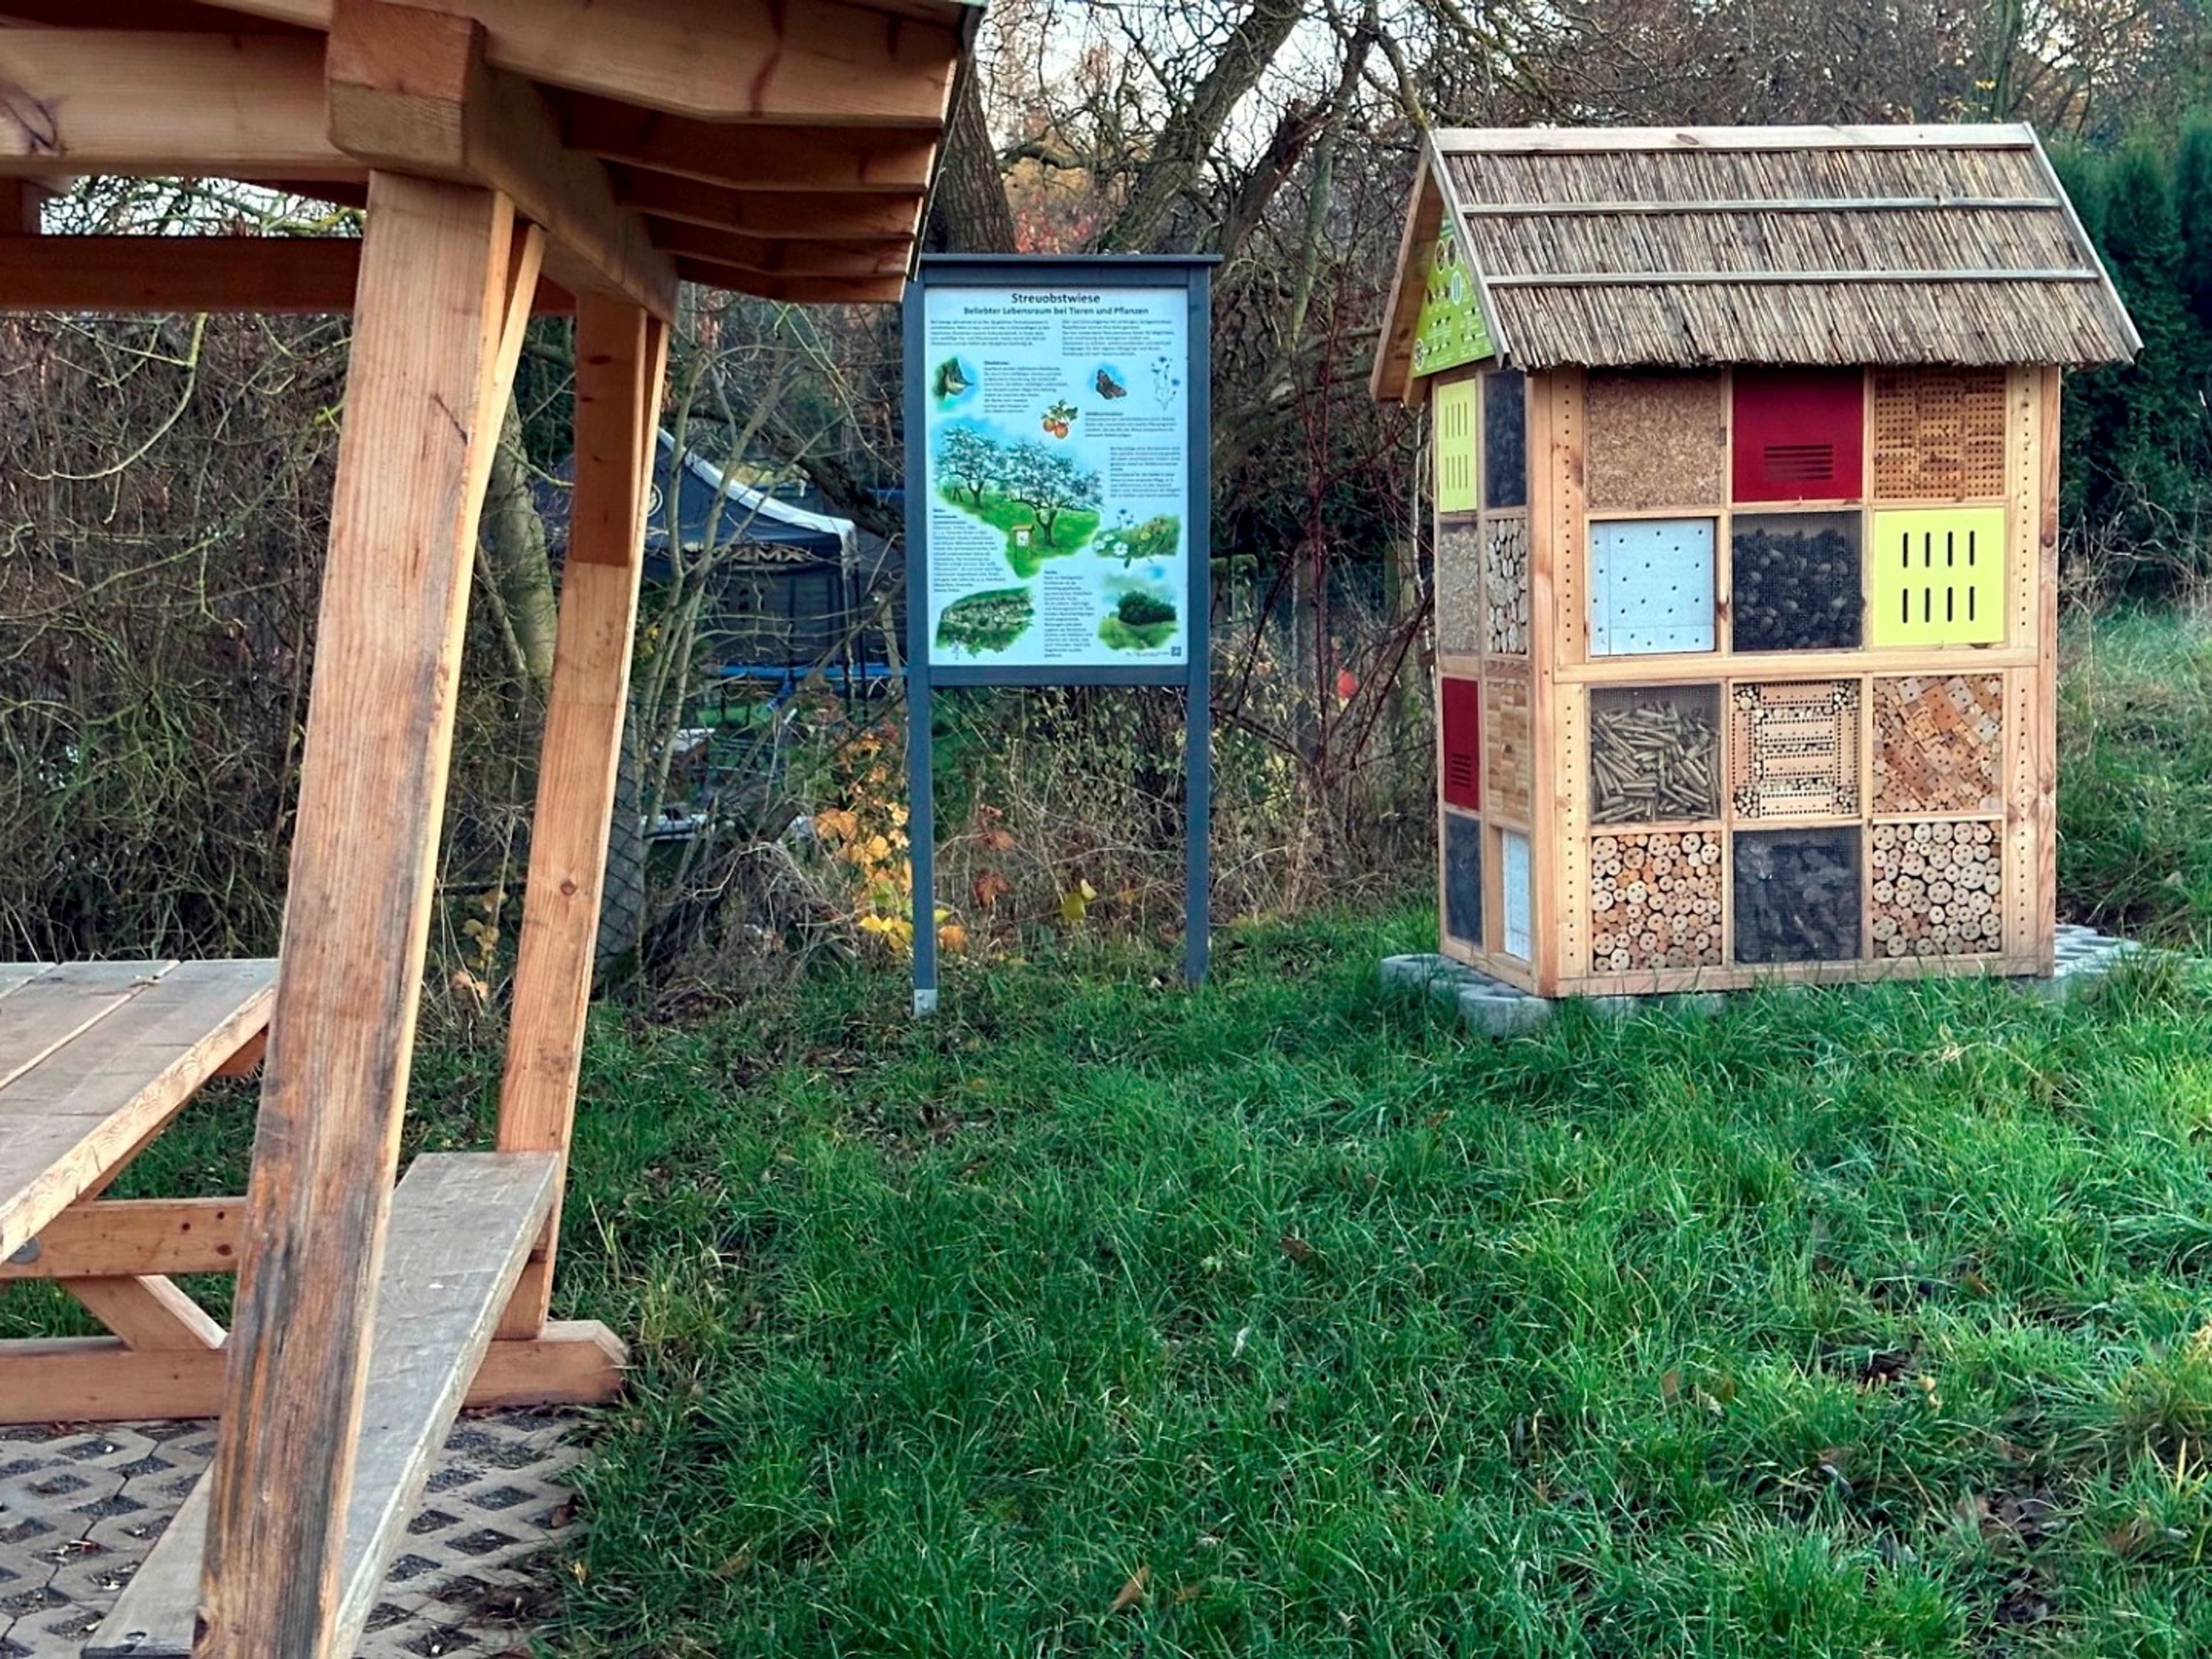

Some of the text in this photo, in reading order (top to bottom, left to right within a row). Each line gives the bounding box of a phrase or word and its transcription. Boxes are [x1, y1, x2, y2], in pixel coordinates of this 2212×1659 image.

[1012, 293, 1101, 304] Streuobstwiese
[964, 306, 1149, 315] Beliebter Lebensraum bei Tieren und Pflanzen
